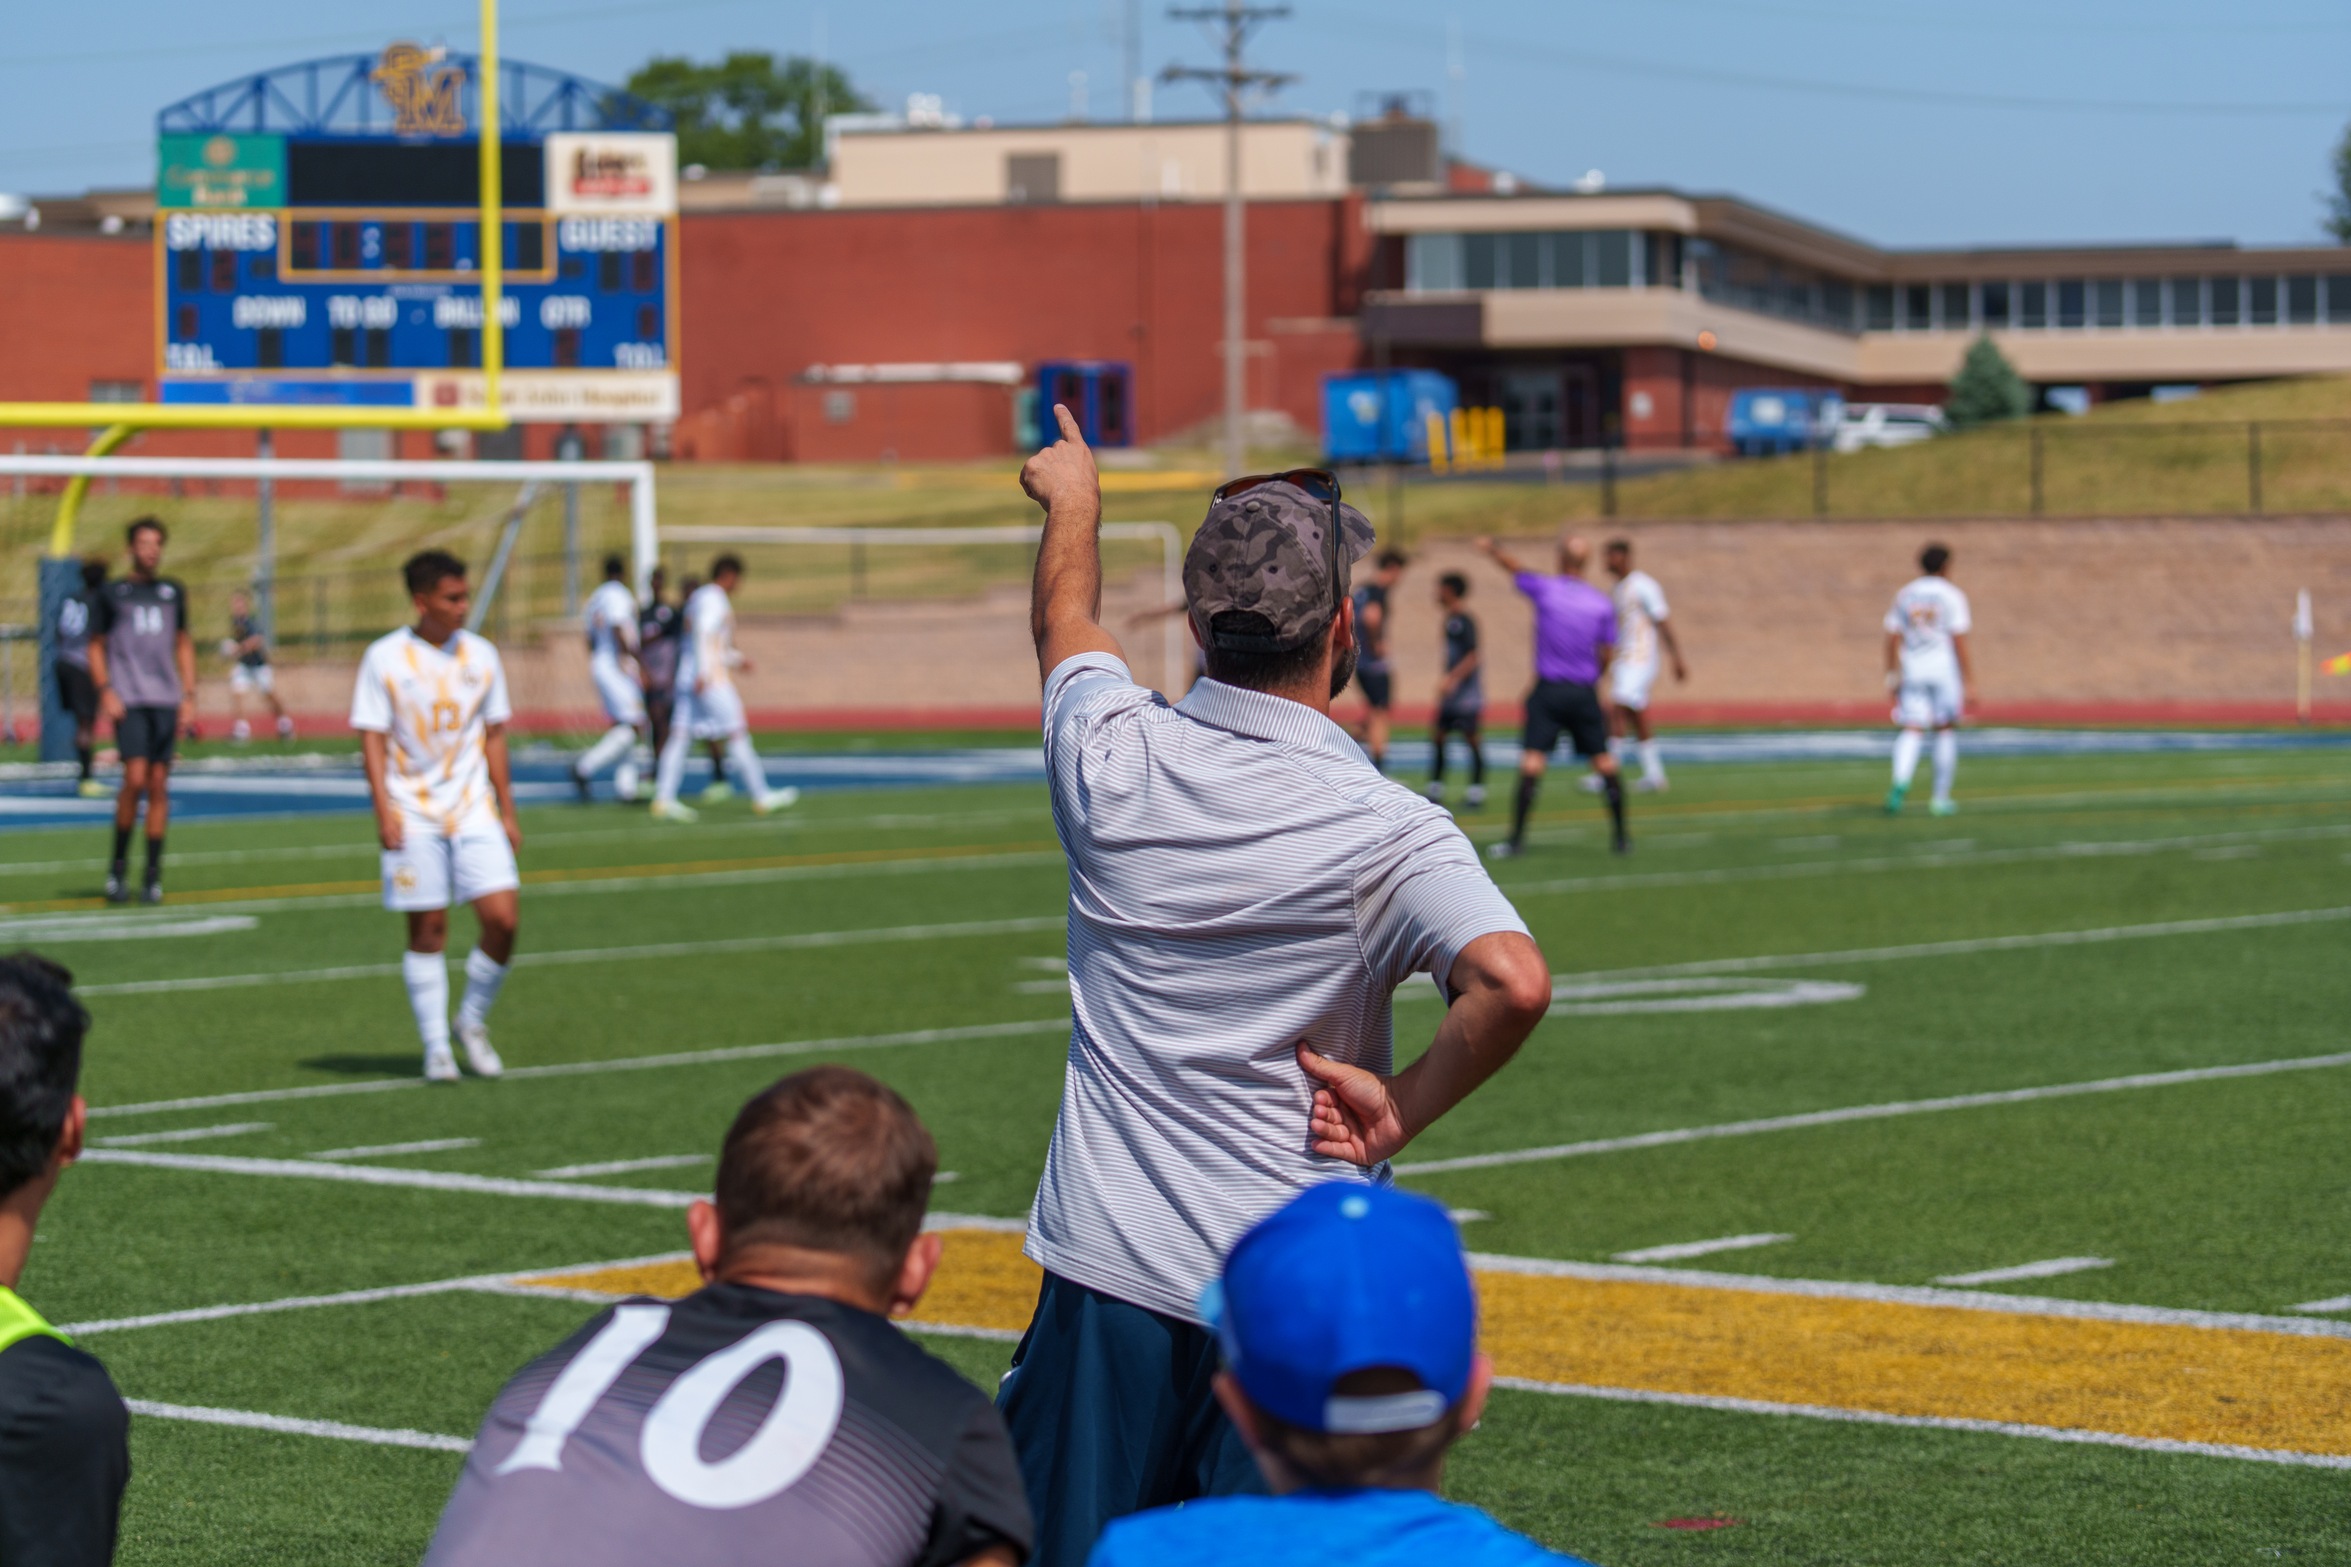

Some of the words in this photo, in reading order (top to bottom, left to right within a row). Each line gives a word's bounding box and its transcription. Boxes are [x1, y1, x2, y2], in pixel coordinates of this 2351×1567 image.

[168, 213, 275, 250] SPIRES
[562, 216, 656, 250] GUEST
[234, 297, 304, 327] DOWN
[329, 297, 362, 327] TO
[363, 297, 397, 327] GO
[542, 297, 589, 328] QTR
[432, 700, 461, 732] 13
[493, 1304, 845, 1510] 10
